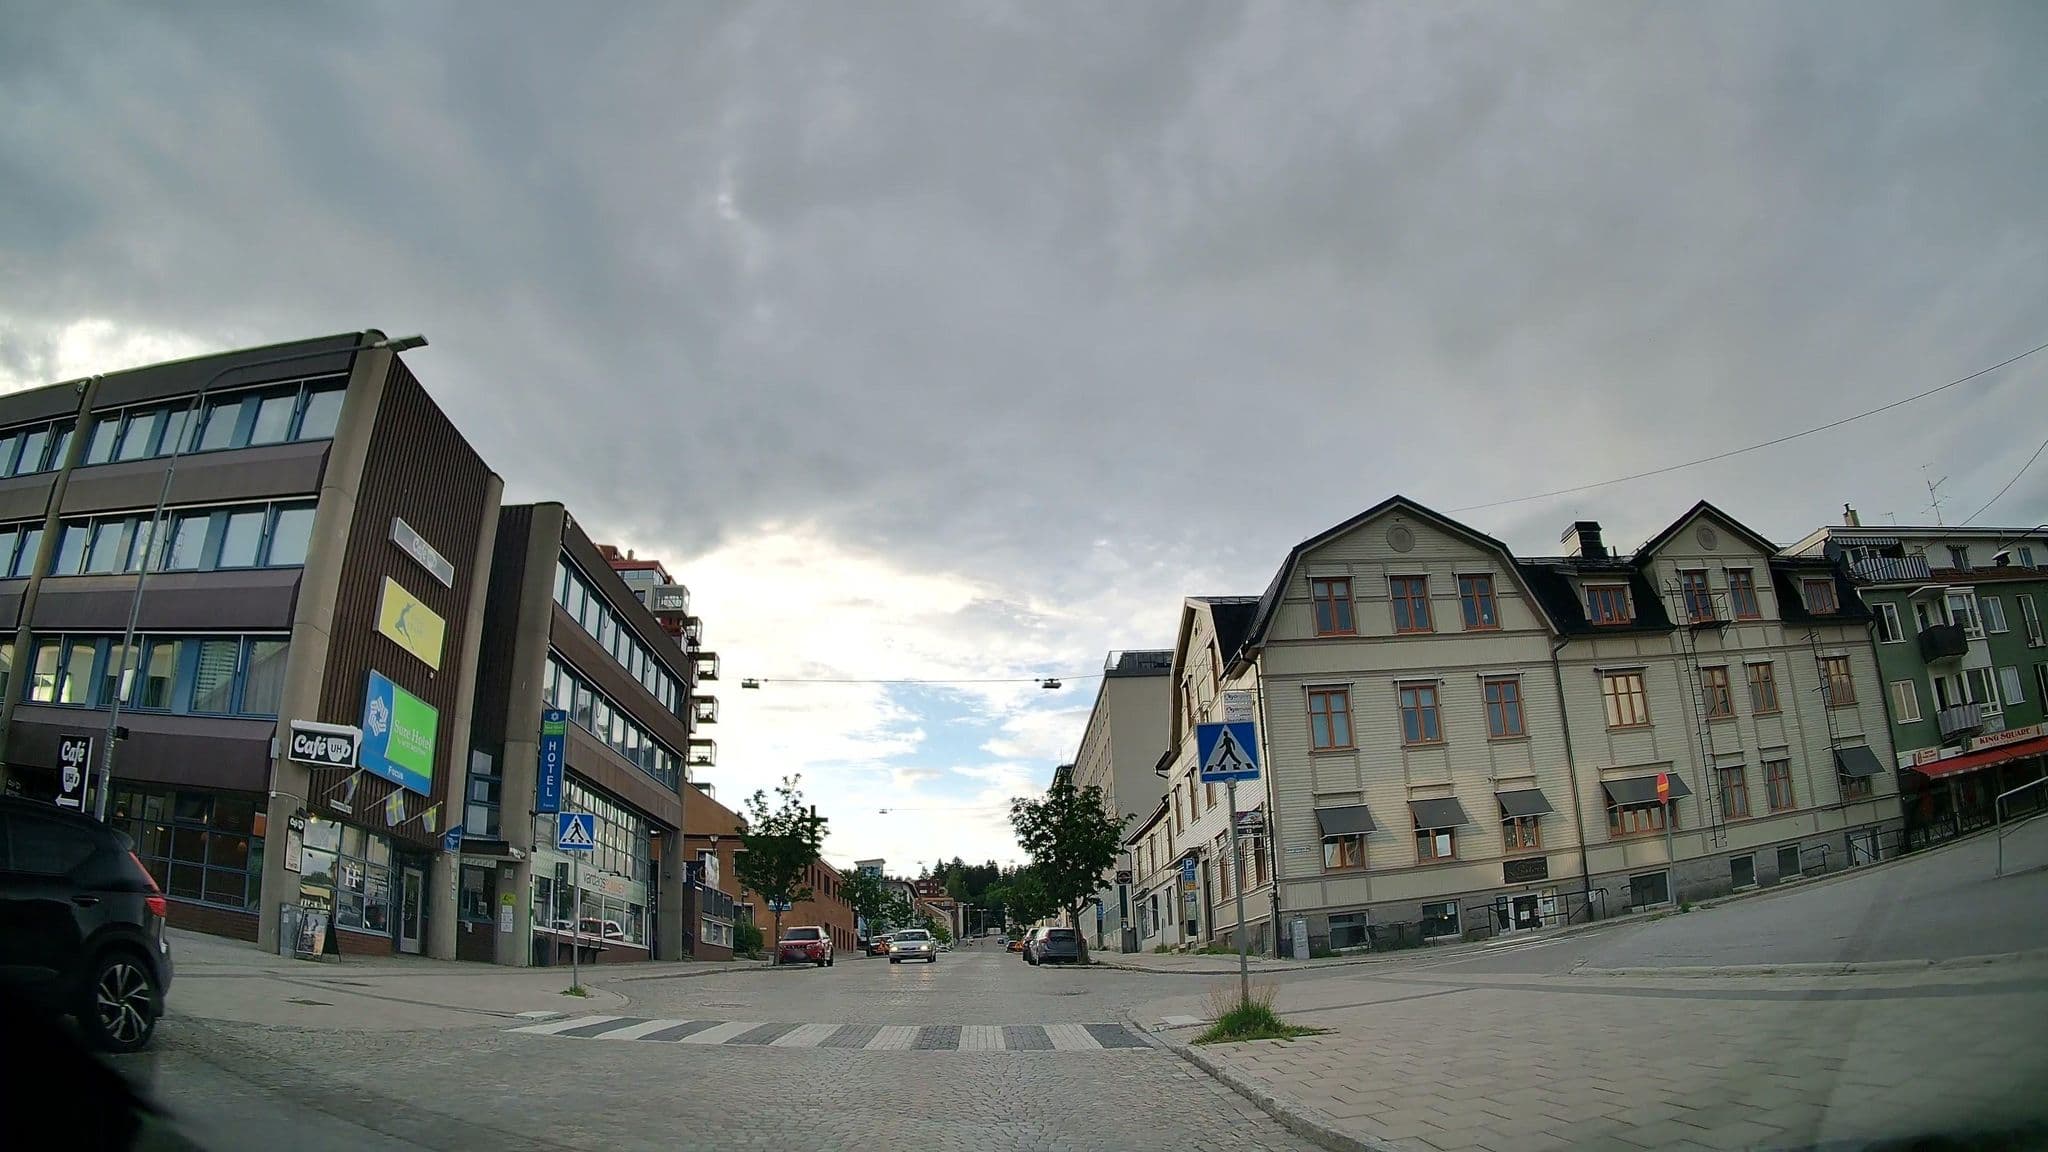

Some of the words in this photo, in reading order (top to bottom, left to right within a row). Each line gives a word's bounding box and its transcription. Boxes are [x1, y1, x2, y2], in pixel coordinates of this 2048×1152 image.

[294, 734, 327, 760] Café
[411, 728, 433, 753] Hotel
[1979, 734, 1999, 745] KING
[1999, 727, 2031, 740] SQUARE
[61, 740, 86, 767] Café
[546, 740, 557, 797] HOTEL
[1185, 859, 1193, 869] P
